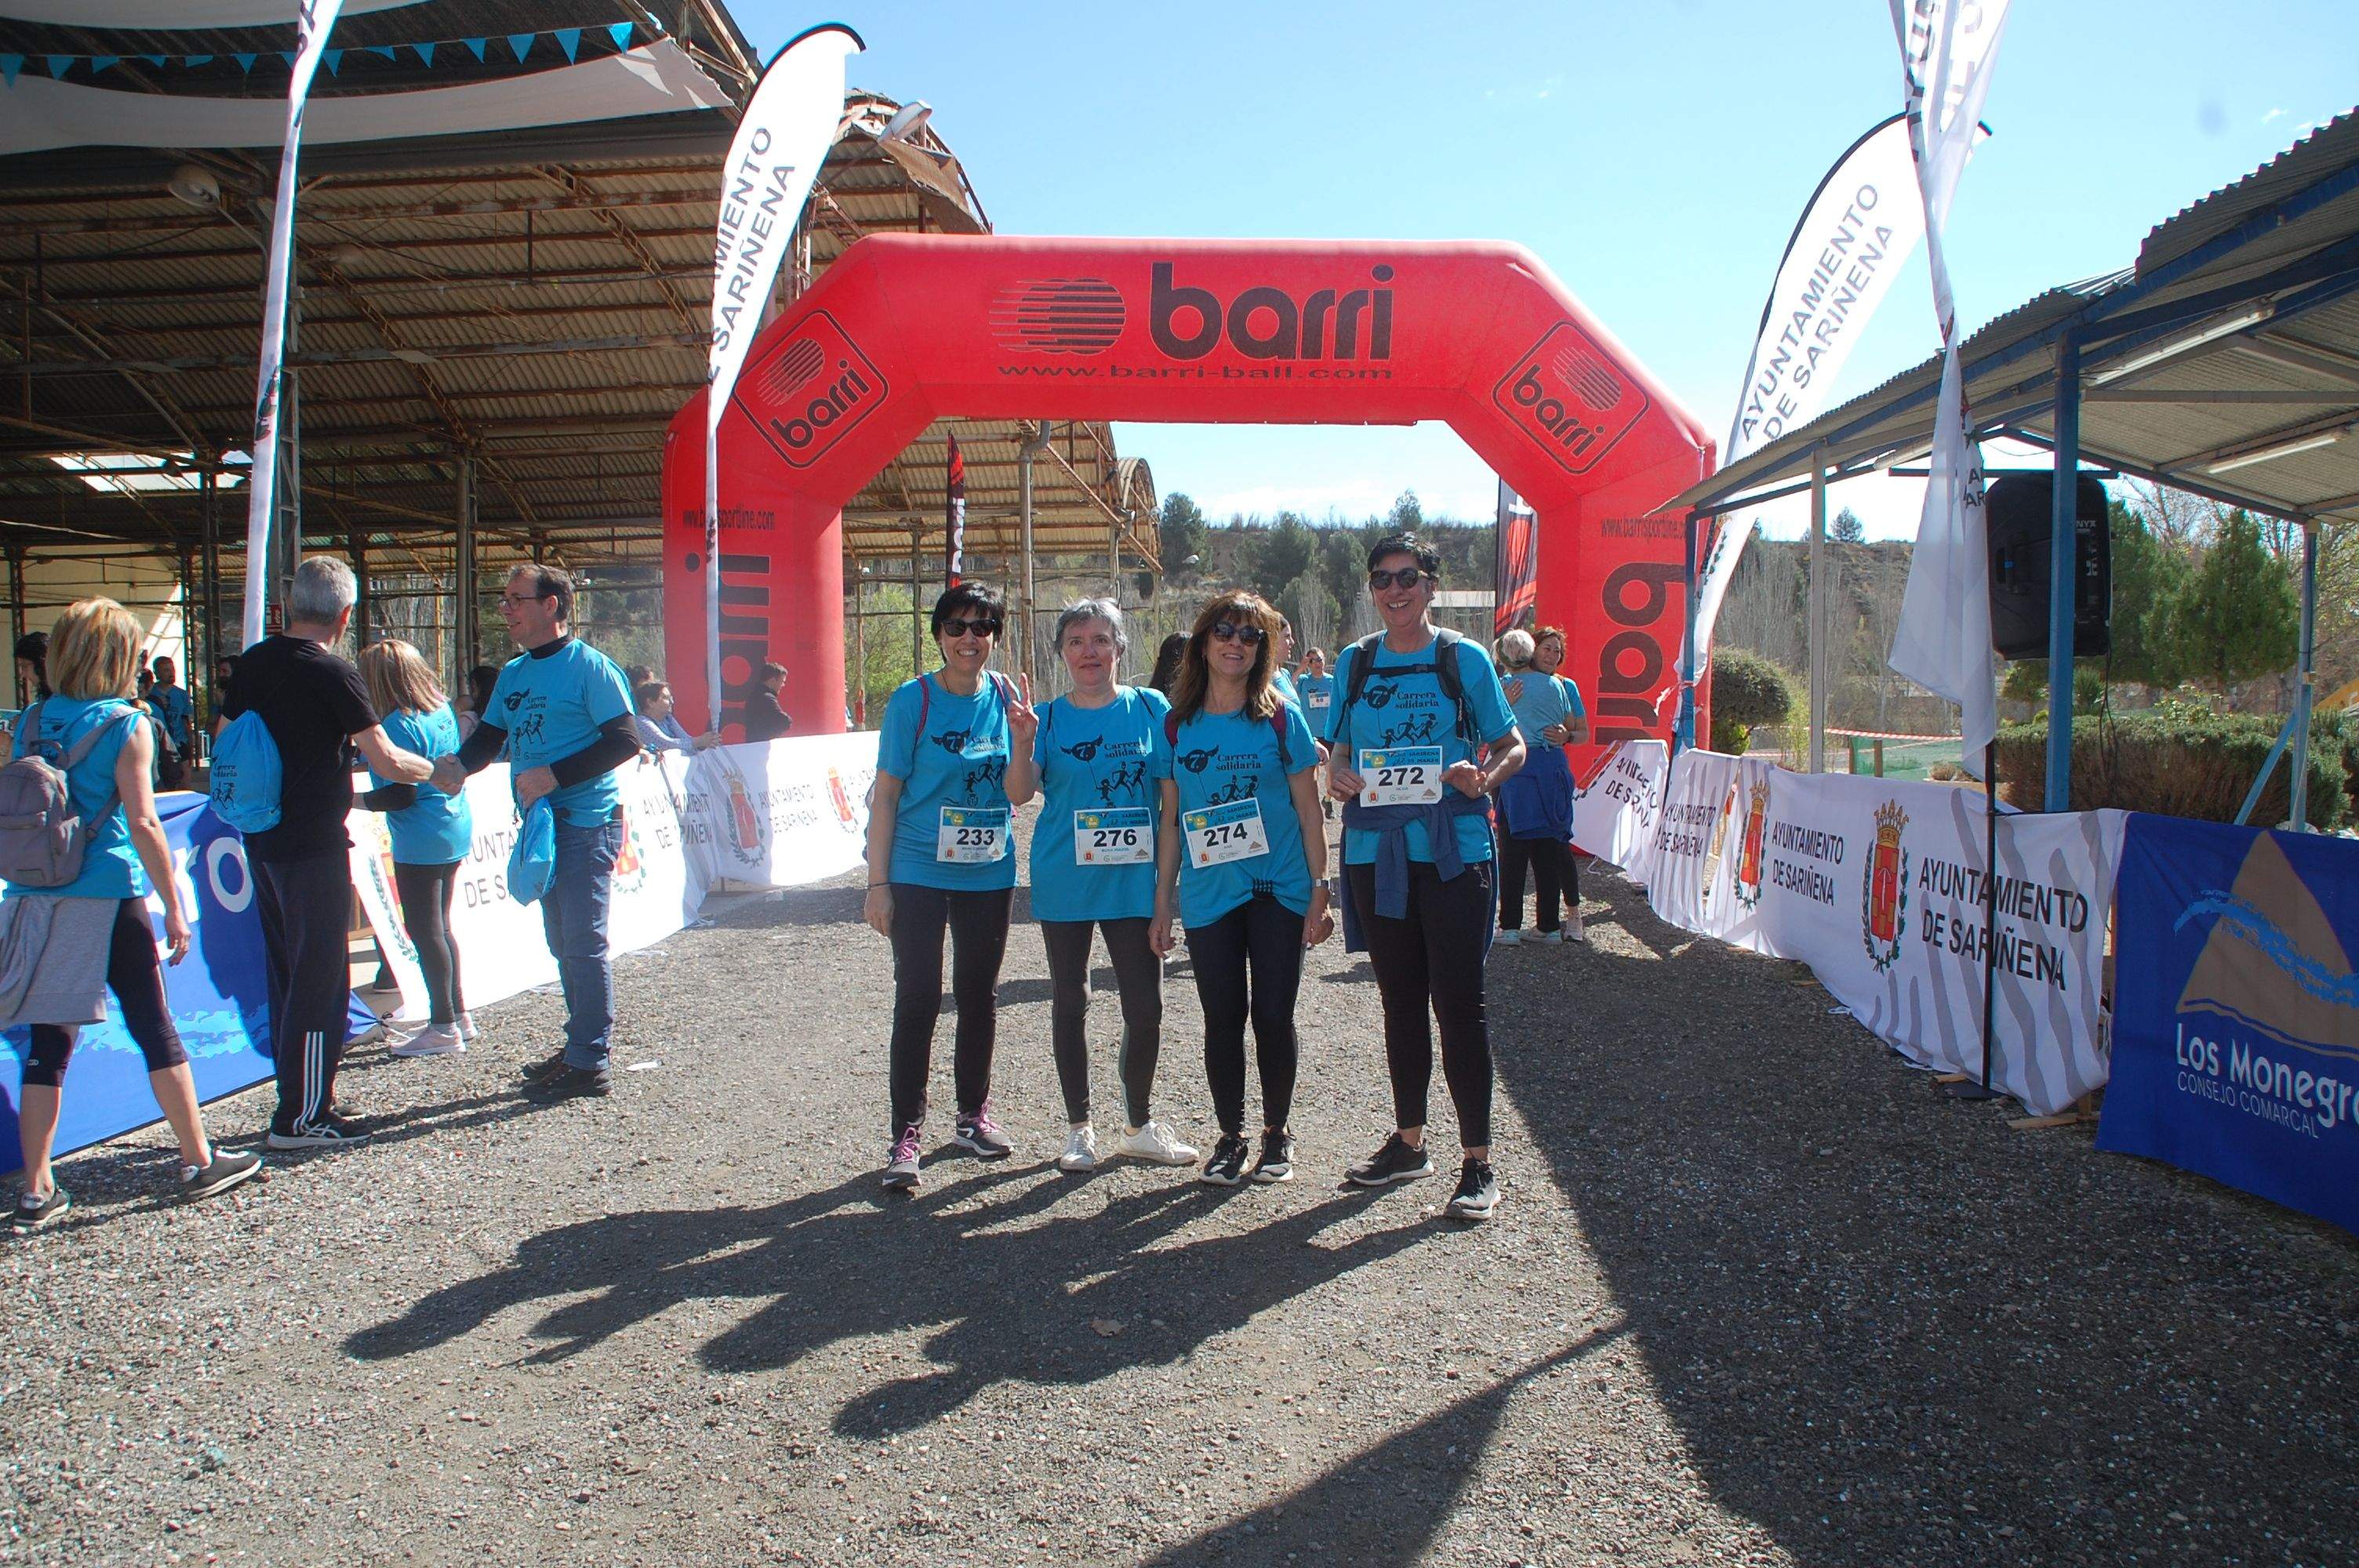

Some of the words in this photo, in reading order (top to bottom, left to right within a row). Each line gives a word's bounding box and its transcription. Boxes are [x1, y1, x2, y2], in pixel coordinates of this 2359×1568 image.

[713, 165, 795, 352] SARIÑENA
[1149, 261, 1395, 361] barri
[1740, 183, 1879, 443] AYUNTAMIENTO
[1762, 395, 1797, 441] DE
[1797, 225, 1894, 390] SARIÑENA
[998, 365, 1392, 379] www.barri-ball.com
[770, 360, 871, 448] barri
[1512, 363, 1606, 457] barri
[1398, 691, 1437, 700] Carrera
[1216, 760, 1262, 771] solidaria
[1217, 753, 1259, 762] Carrera
[1378, 766, 1425, 786] 272
[956, 828, 995, 846] 233
[1093, 828, 1137, 848] 276
[1203, 822, 1249, 848] 274
[1772, 820, 1844, 865] AYUNTAMIENTO
[464, 878, 491, 908] DE
[1772, 858, 1785, 887] DE
[1785, 863, 1834, 906] SARIÑENA
[1918, 857, 2088, 933] AYUNTAMIENTO
[1921, 909, 1946, 948] DE
[1949, 918, 2066, 991] SARIÑENA
[2176, 1022, 2220, 1076] Los
[2177, 1070, 2236, 1107] CONSEJO
[2239, 1091, 2319, 1138] COMARCAL
